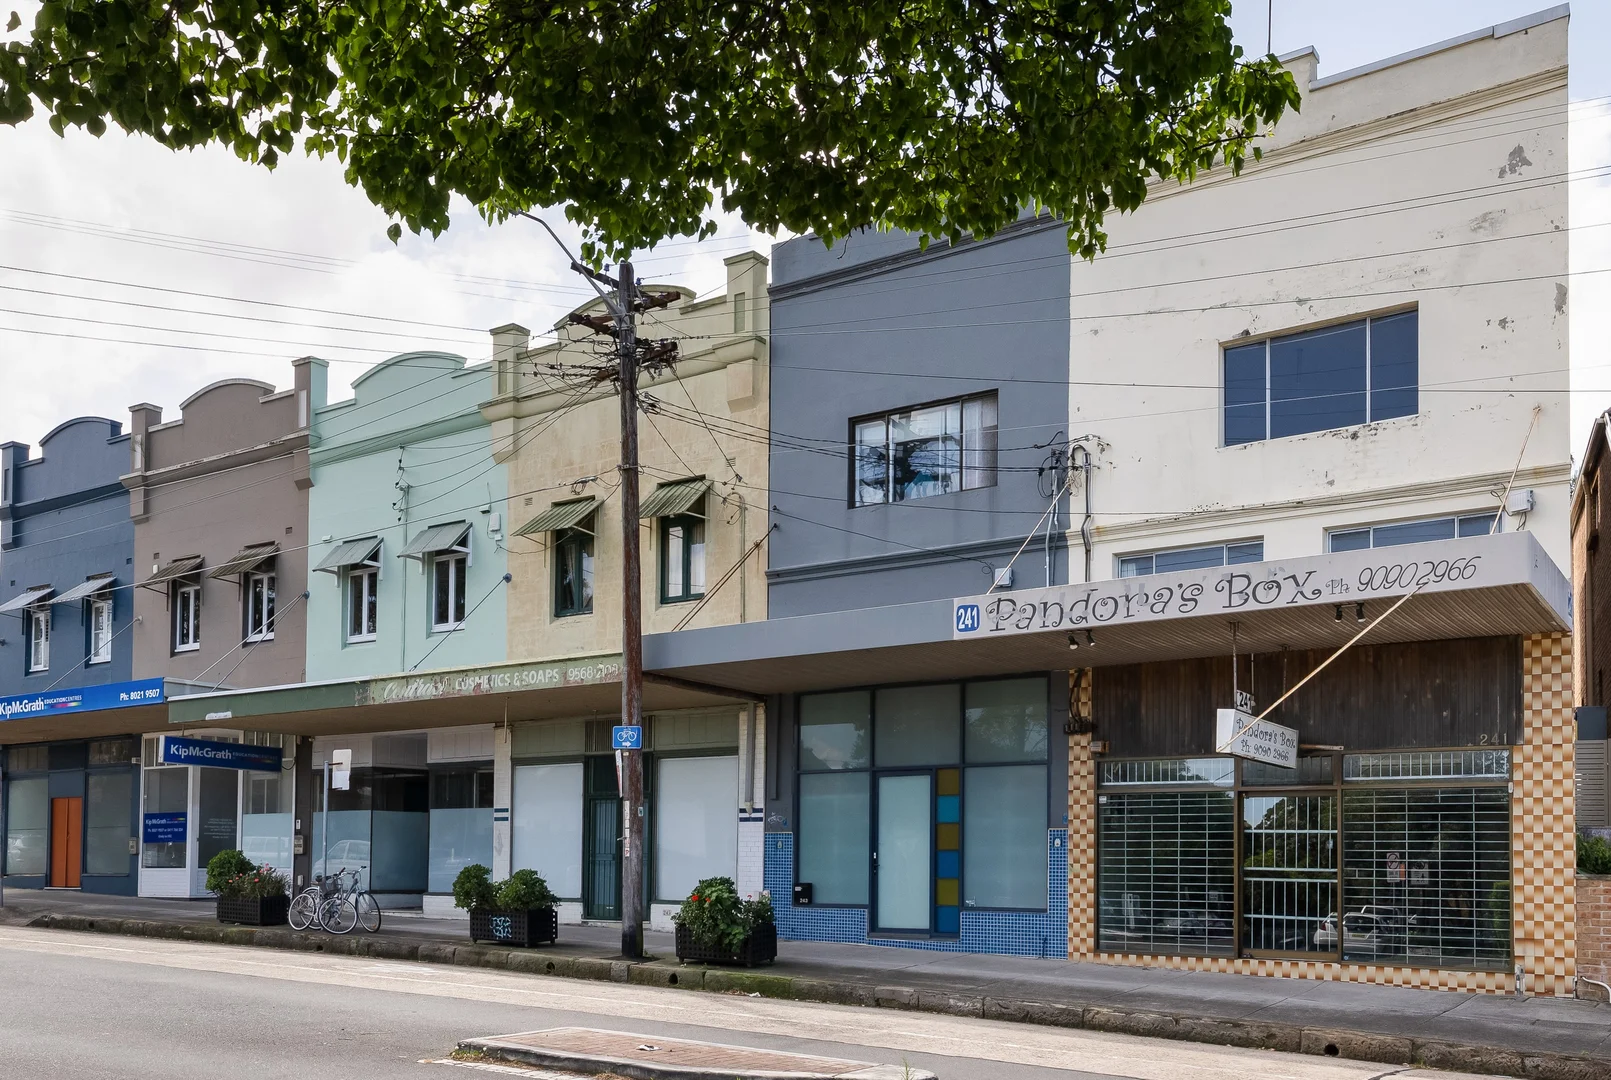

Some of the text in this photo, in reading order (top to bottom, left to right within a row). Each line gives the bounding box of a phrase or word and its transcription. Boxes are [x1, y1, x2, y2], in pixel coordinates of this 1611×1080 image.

[957, 606, 979, 630] 241
[985, 583, 1203, 632] Pandora's
[1325, 578, 1350, 596] Ph
[513, 672, 521, 687] &
[522, 668, 559, 685] SOAPS
[130, 690, 144, 700] 8021
[145, 688, 160, 699] 9507
[1236, 717, 1278, 744] Pandora's
[1480, 732, 1507, 746] 241
[1253, 743, 1271, 757] 9090
[1273, 747, 1289, 762] 2966
